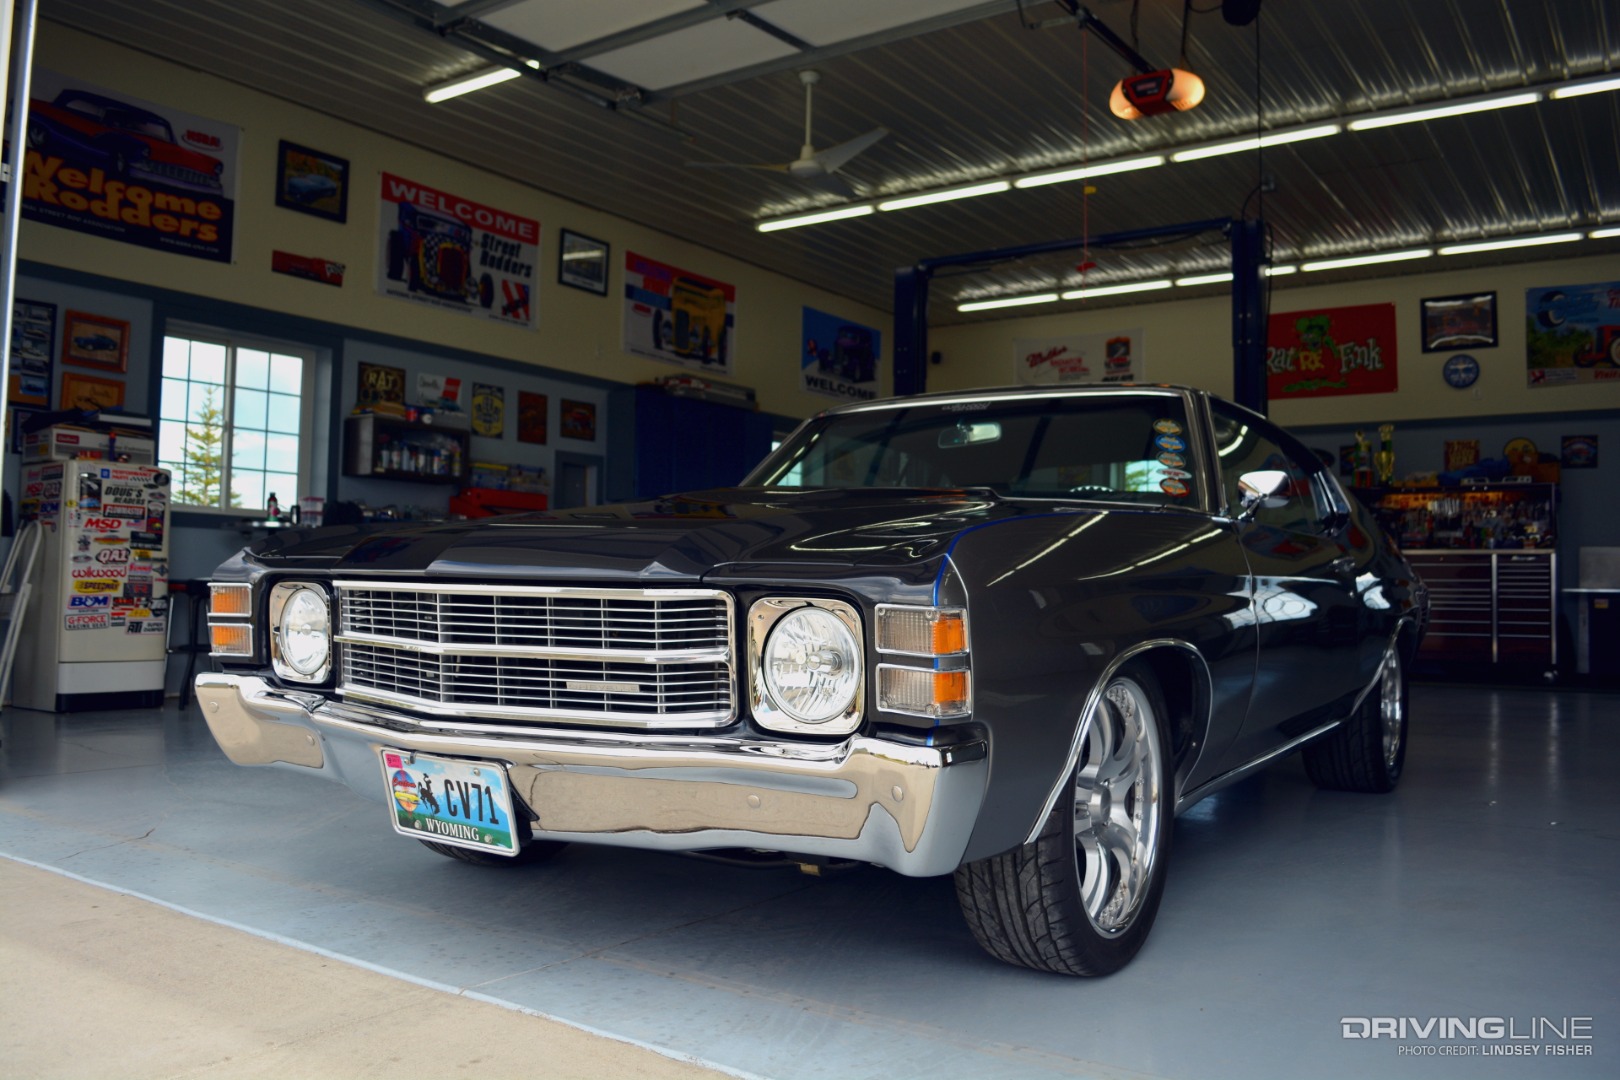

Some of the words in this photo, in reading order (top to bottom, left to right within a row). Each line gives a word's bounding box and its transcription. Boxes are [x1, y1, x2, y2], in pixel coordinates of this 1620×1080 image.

[23, 178, 219, 242] Rodders
[390, 179, 534, 239] WELCOME
[480, 233, 521, 258] Street
[479, 250, 532, 278] Rodders
[1338, 337, 1385, 374] Fink
[805, 375, 876, 400] WELCOME
[105, 486, 143, 497] DOUG'S
[84, 517, 122, 530] MSD
[100, 548, 129, 563] QA1
[72, 566, 127, 578] wilwood
[67, 615, 107, 624] G-FORCE
[443, 779, 499, 825] CV71
[425, 817, 480, 841] WYOMING
